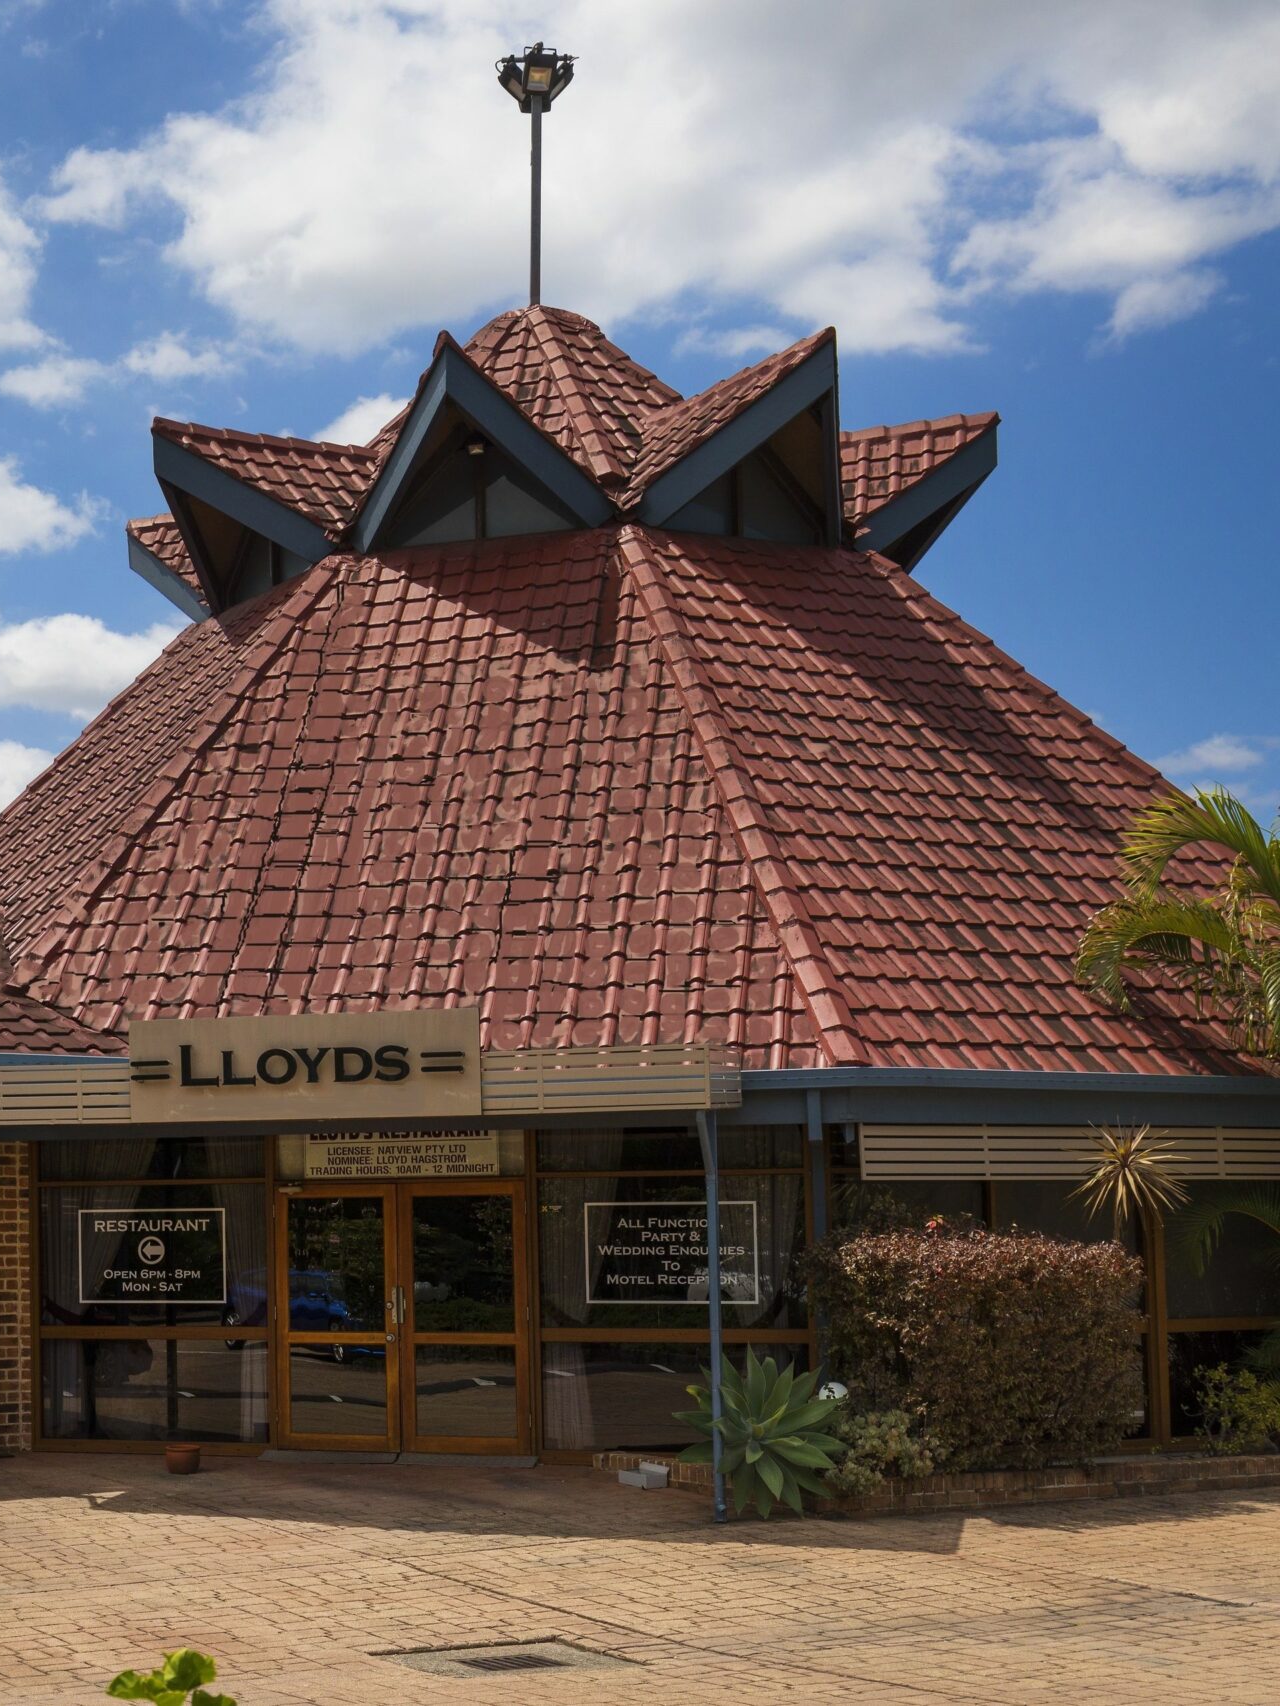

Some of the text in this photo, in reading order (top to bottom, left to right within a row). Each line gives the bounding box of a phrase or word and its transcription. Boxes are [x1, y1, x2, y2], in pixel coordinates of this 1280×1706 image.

[179, 1044, 410, 1087] LLOYDS
[327, 1144, 466, 1156] LICENSEE: NATVIEW PTY LTD
[327, 1154, 467, 1165] NOMINEE: LLOYD HAGSTROM
[310, 1166, 352, 1176] TRADING
[356, 1165, 392, 1175] HOURS:
[396, 1165, 422, 1174] 10AM
[431, 1164, 443, 1173] 12
[446, 1163, 495, 1174] MIDNIGHT
[94, 1219, 210, 1233] RESTAURANT
[617, 1217, 723, 1229] ALL FUNCTIO,
[641, 1231, 701, 1242] PARTY &
[597, 1245, 745, 1257] WEDDING ENQURIES
[661, 1260, 680, 1271] TO
[103, 1269, 137, 1279] OPEN
[140, 1269, 166, 1279] 6PM
[174, 1269, 201, 1279] 8PM
[606, 1274, 738, 1285] MOTEL RECEPON
[122, 1282, 150, 1292] MON
[159, 1281, 183, 1292] SAT
